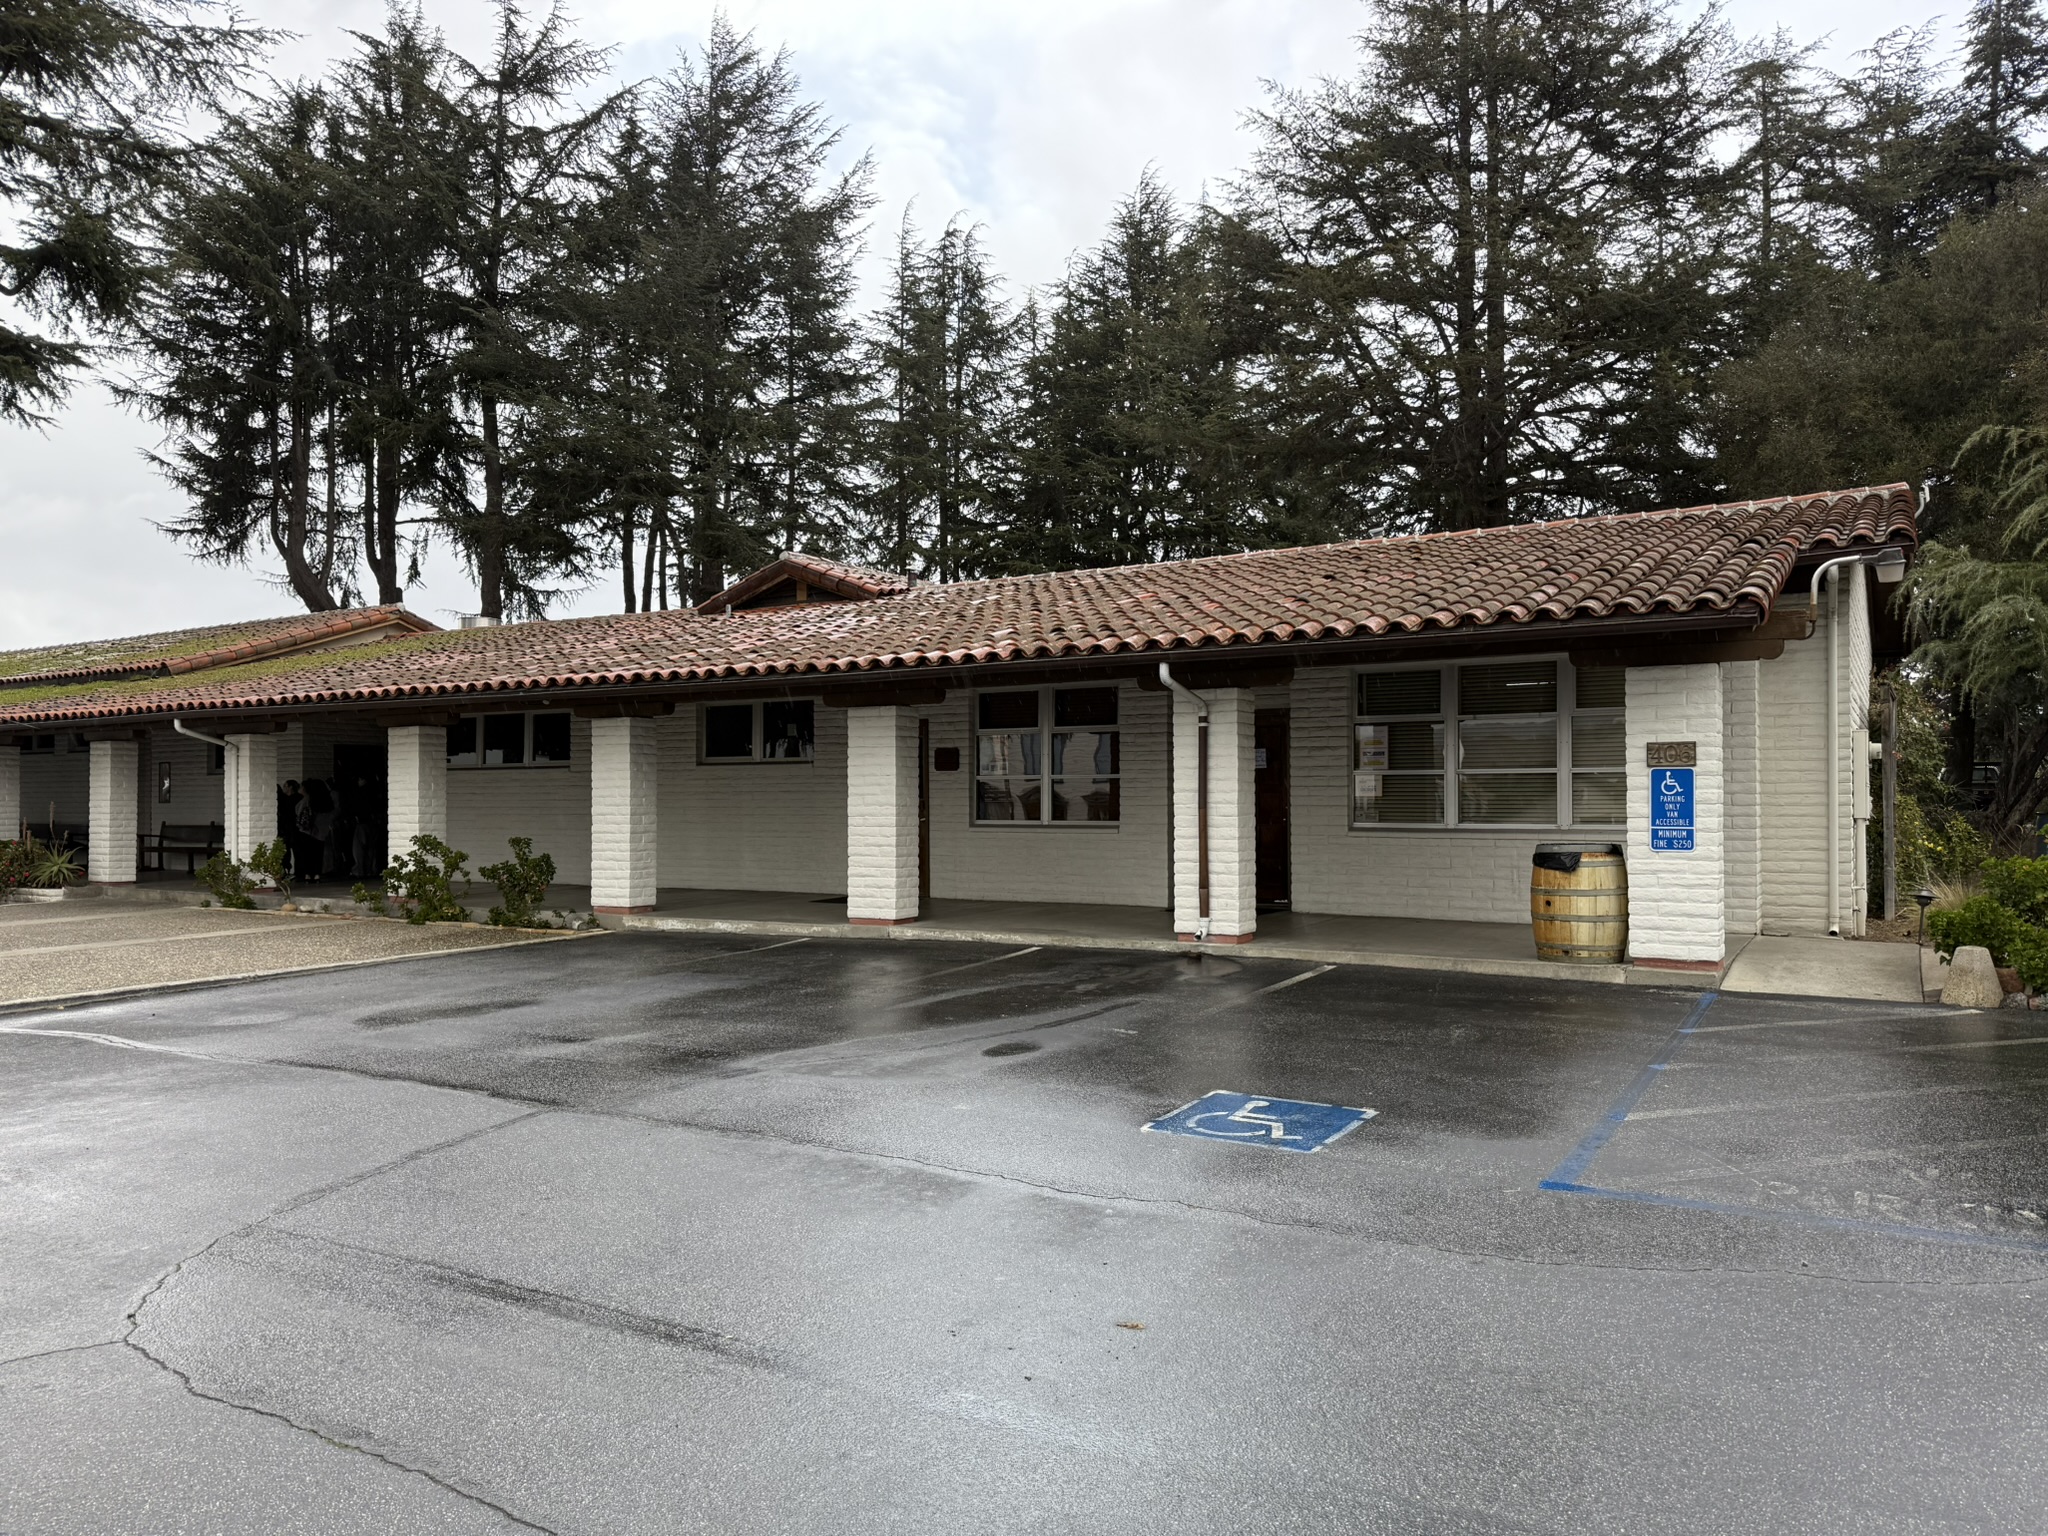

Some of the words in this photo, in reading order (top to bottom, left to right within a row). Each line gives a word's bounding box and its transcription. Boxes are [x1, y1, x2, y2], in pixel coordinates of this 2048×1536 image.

[1650, 744, 1692, 763] 406
[1658, 830, 1687, 838] MINIMUM
[1653, 840, 1668, 848] FINE
[1673, 840, 1692, 848] $250
